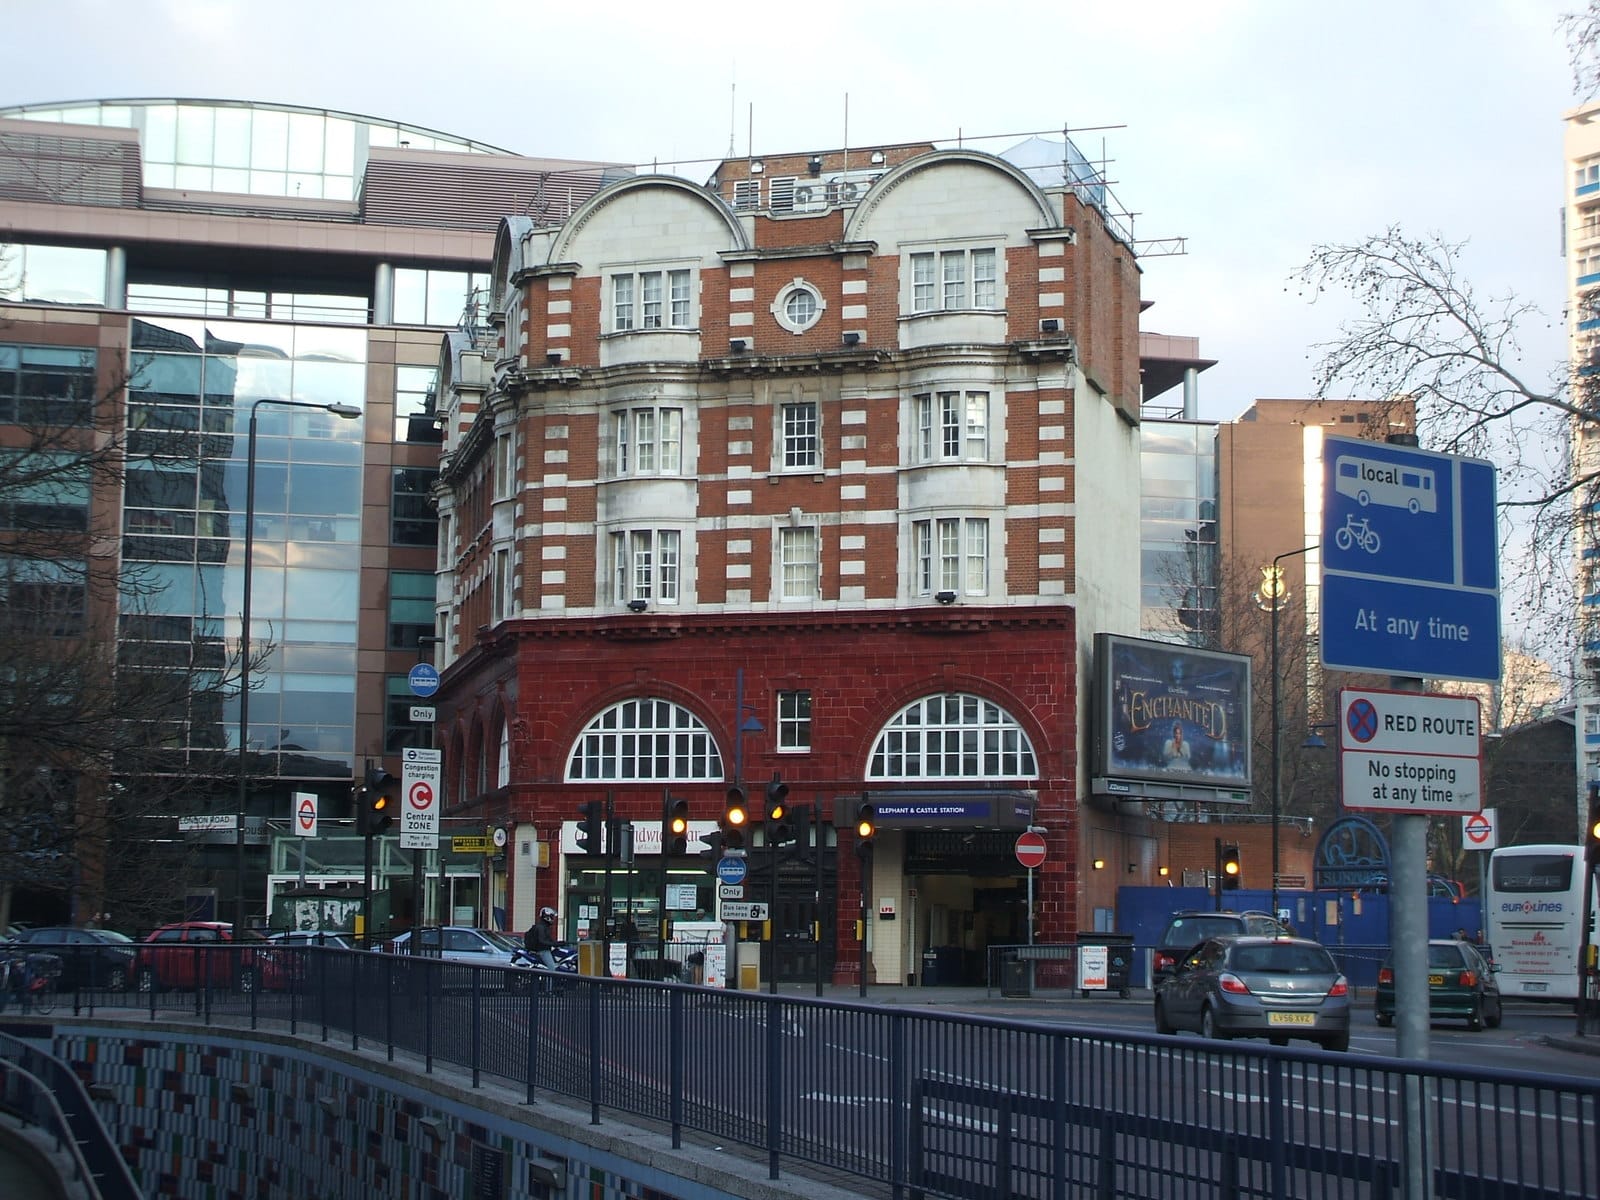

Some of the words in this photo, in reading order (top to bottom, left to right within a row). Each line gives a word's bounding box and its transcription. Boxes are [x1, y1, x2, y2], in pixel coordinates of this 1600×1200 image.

[1361, 463, 1399, 485] local
[1355, 608, 1377, 632] At
[1386, 616, 1420, 640] any
[1427, 616, 1469, 642] time
[413, 709, 433, 719] Only
[1130, 690, 1227, 739] ENCHANTED
[1384, 714, 1417, 732] RED
[1423, 717, 1475, 736] ROUTE
[404, 763, 439, 773] Congestion
[1368, 760, 1390, 778] No
[1395, 762, 1456, 784] stopping
[408, 772, 435, 780] charging
[1372, 783, 1388, 799] at
[1391, 786, 1417, 804] any
[1421, 785, 1453, 802] time
[406, 812, 434, 820] Central
[408, 821, 432, 830] ZONE
[722, 888, 741, 896] Only
